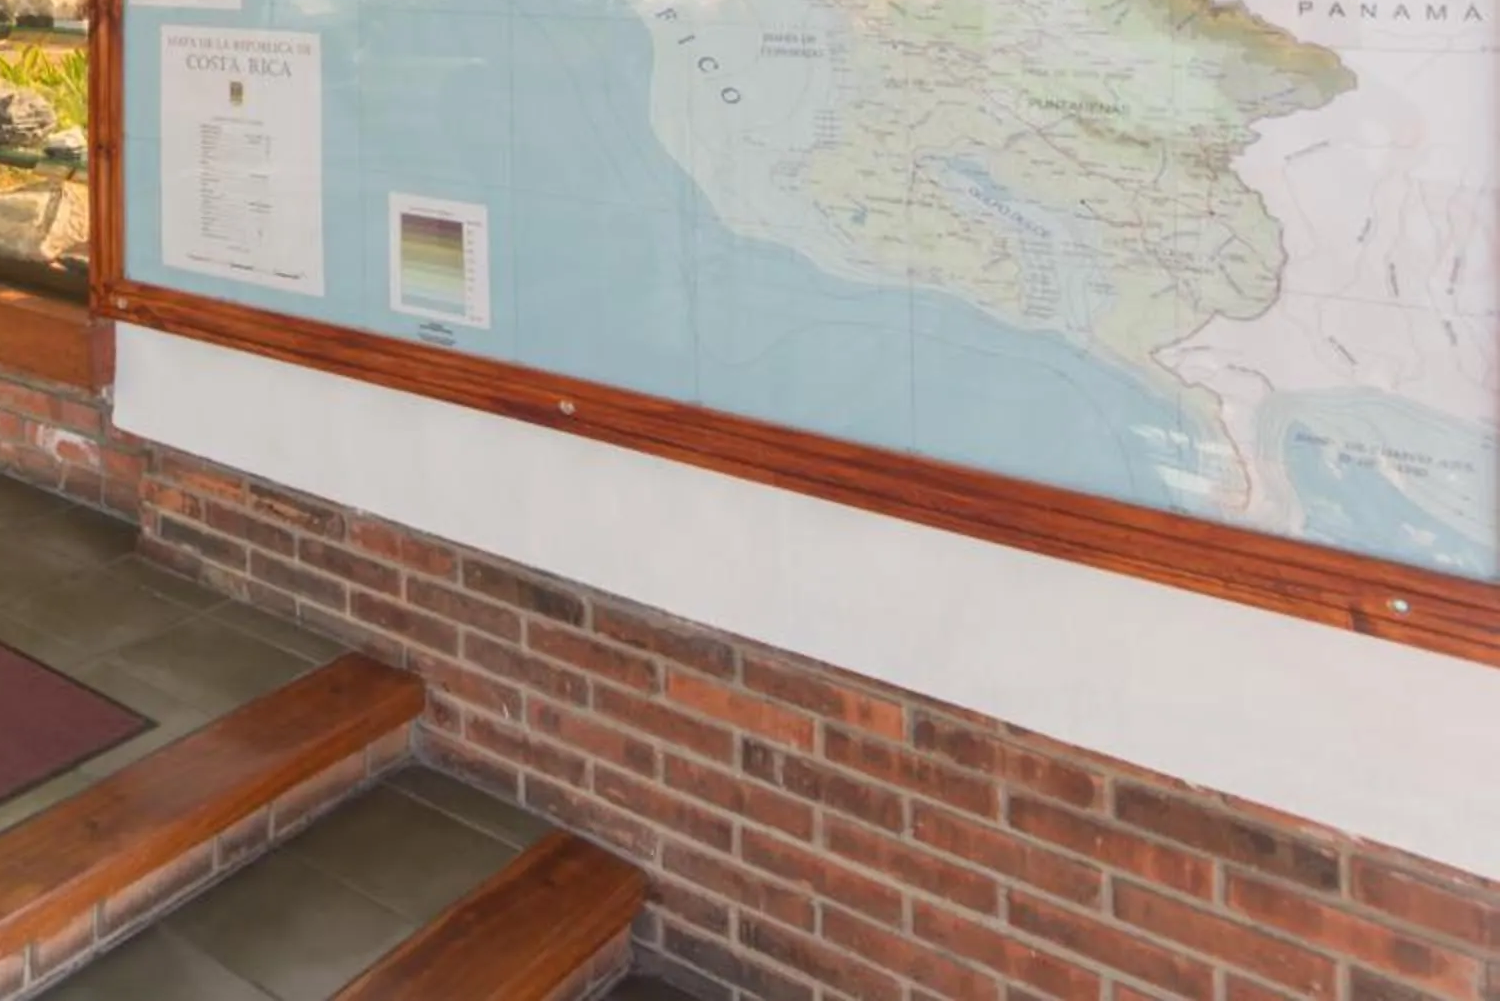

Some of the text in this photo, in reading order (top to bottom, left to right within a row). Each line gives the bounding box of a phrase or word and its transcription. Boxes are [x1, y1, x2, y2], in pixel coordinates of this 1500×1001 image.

[1298, 0, 1483, 22] PANAMA
[185, 53, 293, 78] COSTA RICA
